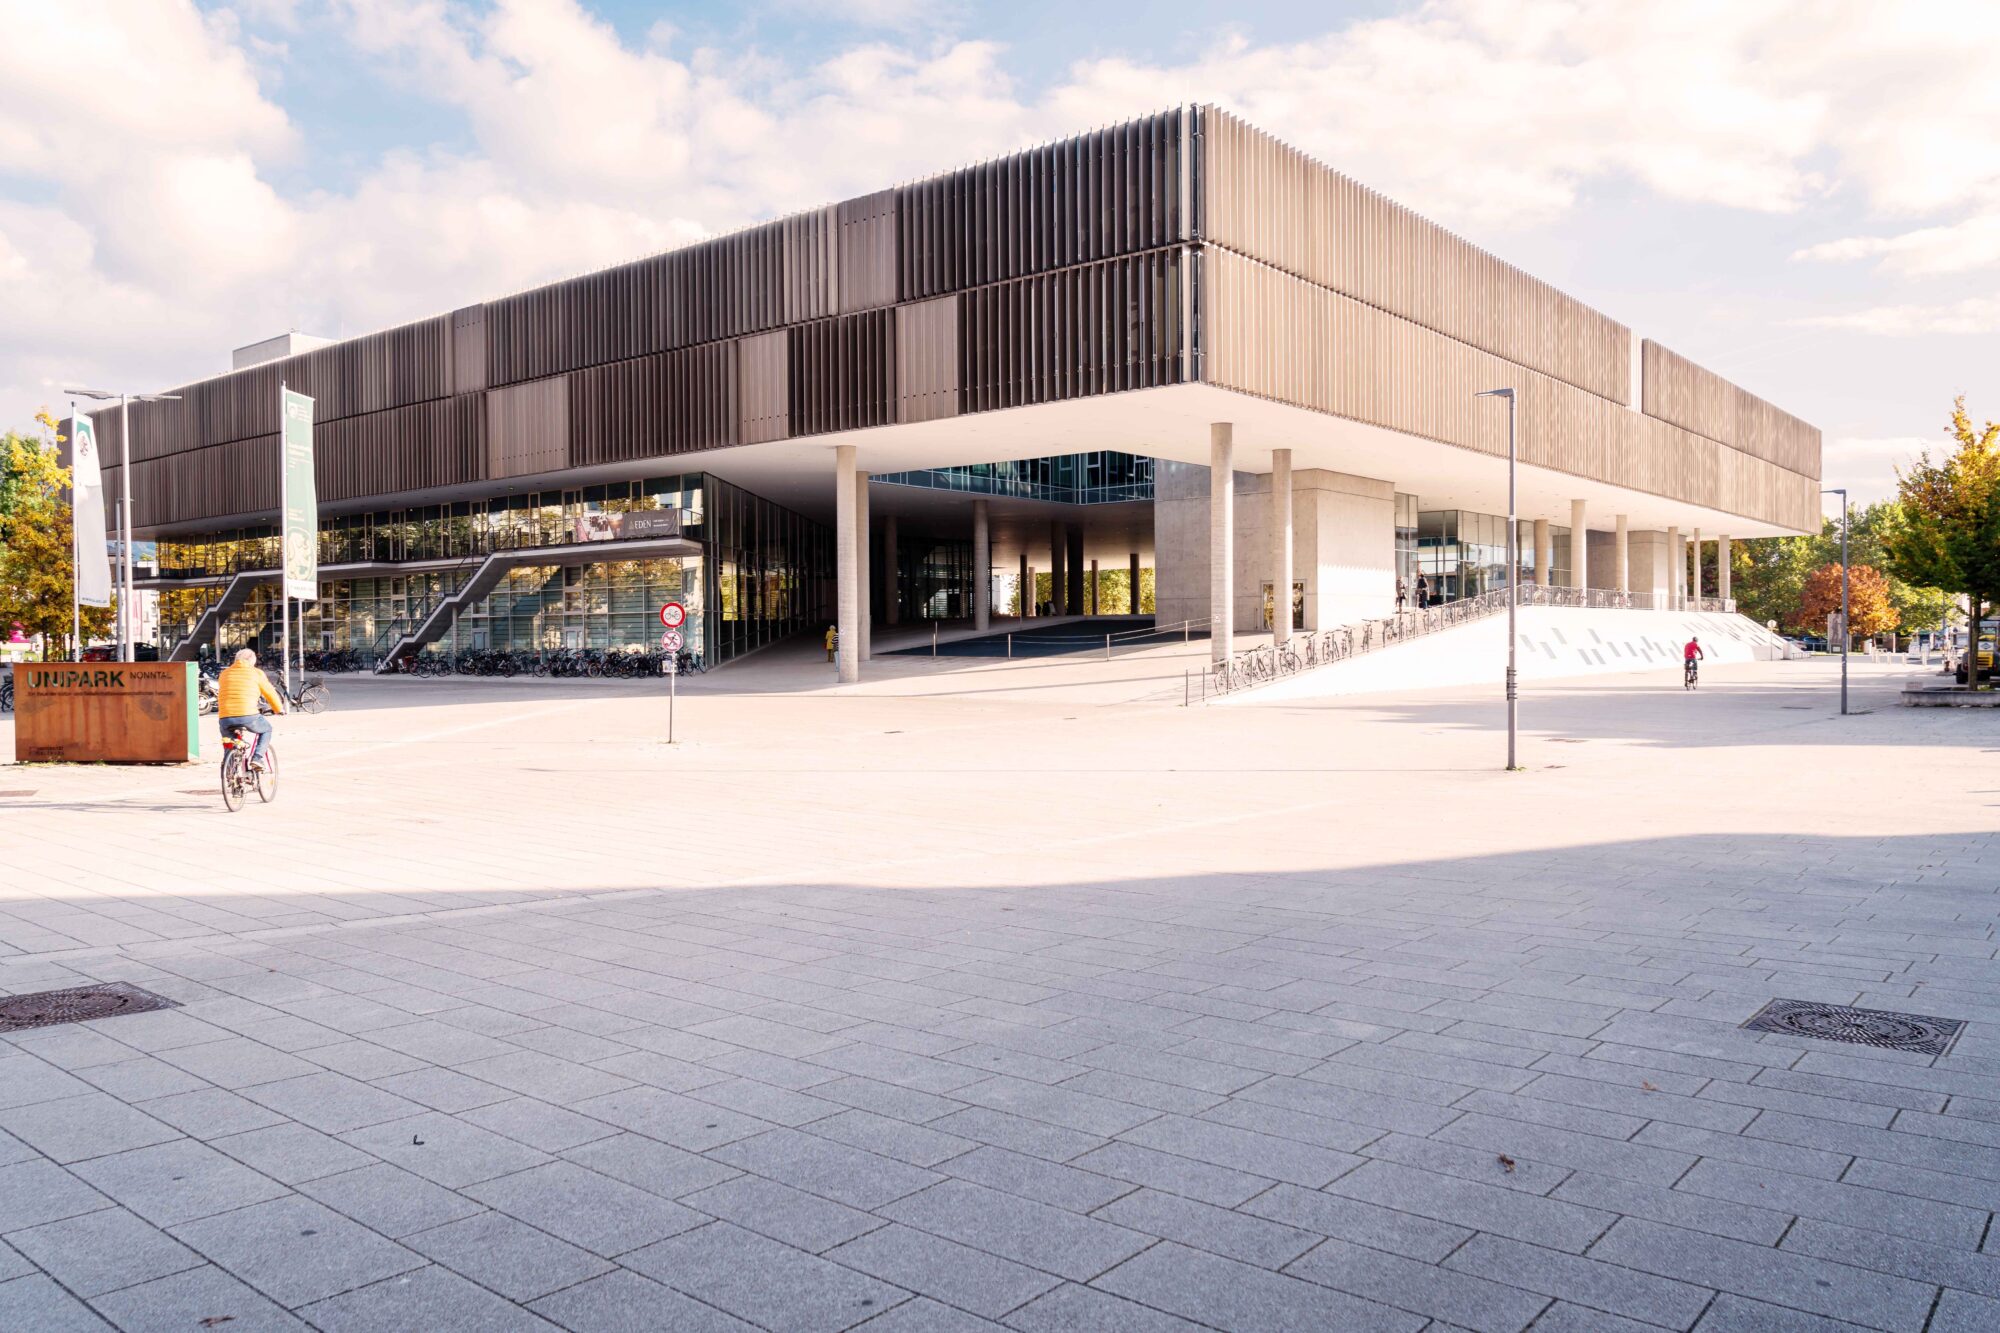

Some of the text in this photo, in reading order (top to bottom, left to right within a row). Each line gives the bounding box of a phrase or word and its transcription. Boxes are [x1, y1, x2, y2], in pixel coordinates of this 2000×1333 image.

[634, 520, 652, 529] EDEN
[27, 671, 173, 688] UNIPARK NONNTAL
